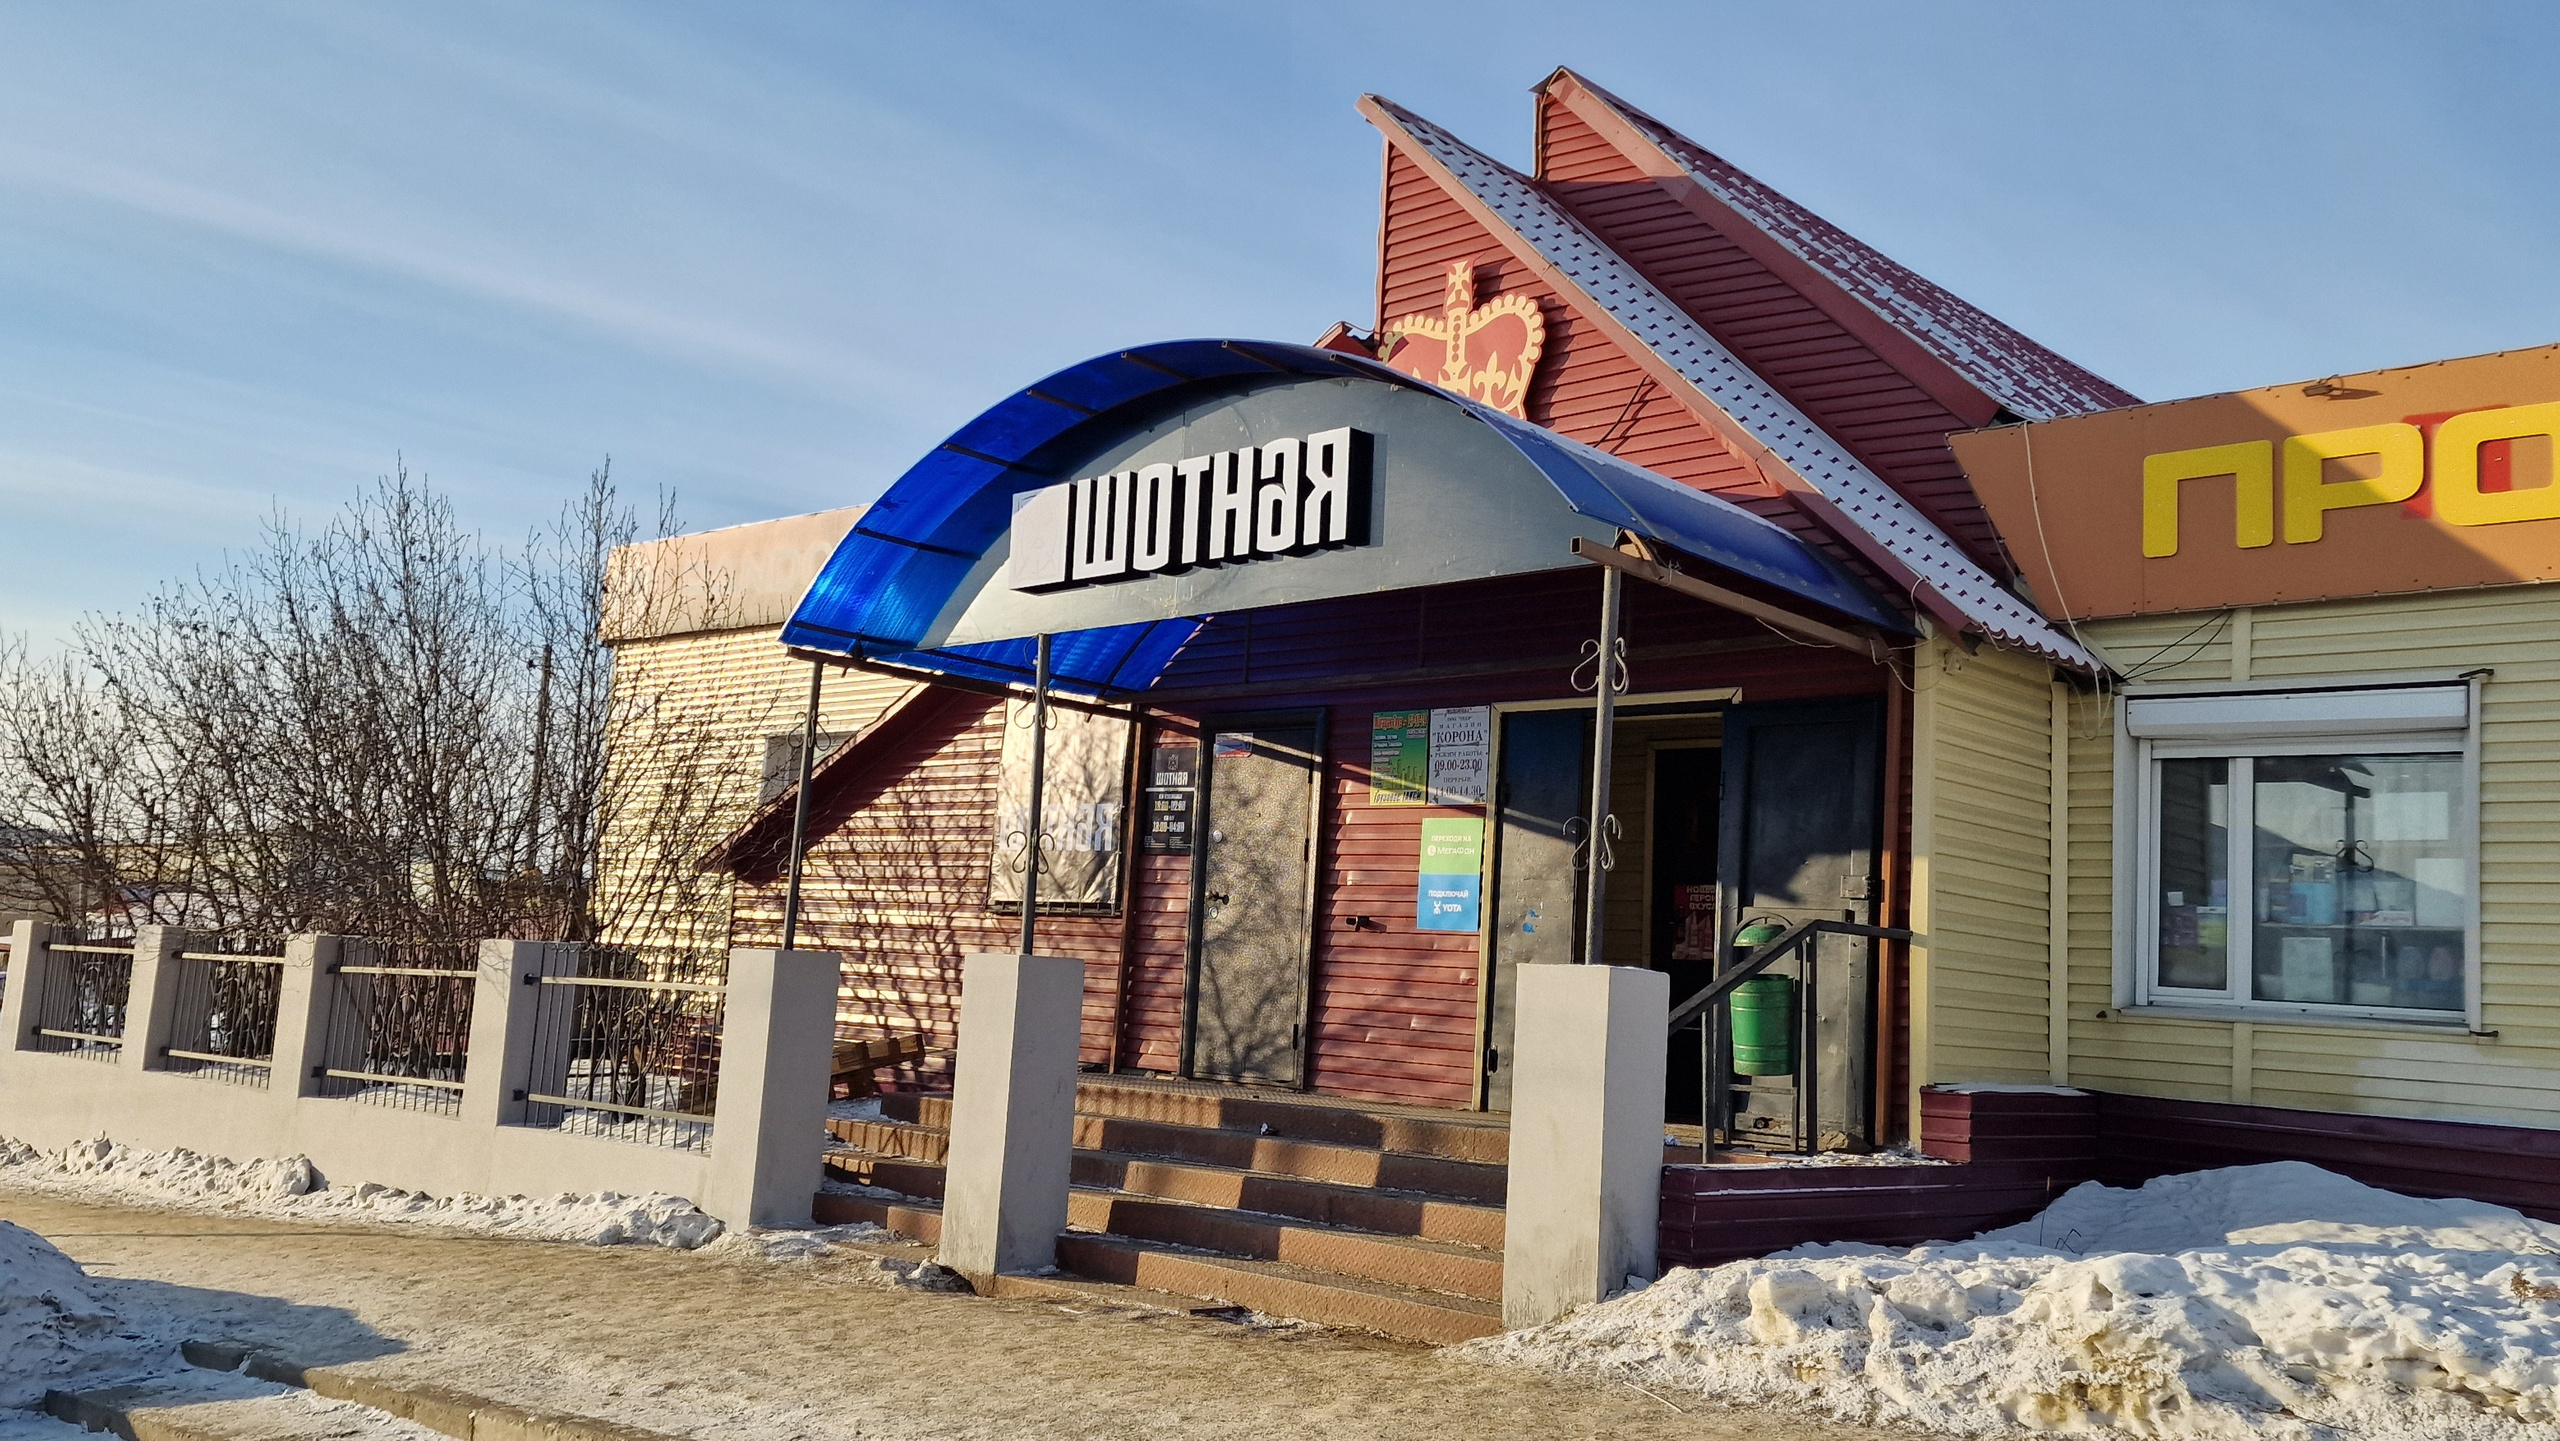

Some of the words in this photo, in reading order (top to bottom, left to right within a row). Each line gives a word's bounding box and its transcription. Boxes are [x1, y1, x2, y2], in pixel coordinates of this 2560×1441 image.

[2142, 401, 2560, 559] ПРО
[1432, 729, 1488, 744] "КОРОНА"
[1434, 758, 1483, 771] 09.00-23.00
[1442, 904, 1462, 912] YOTA
